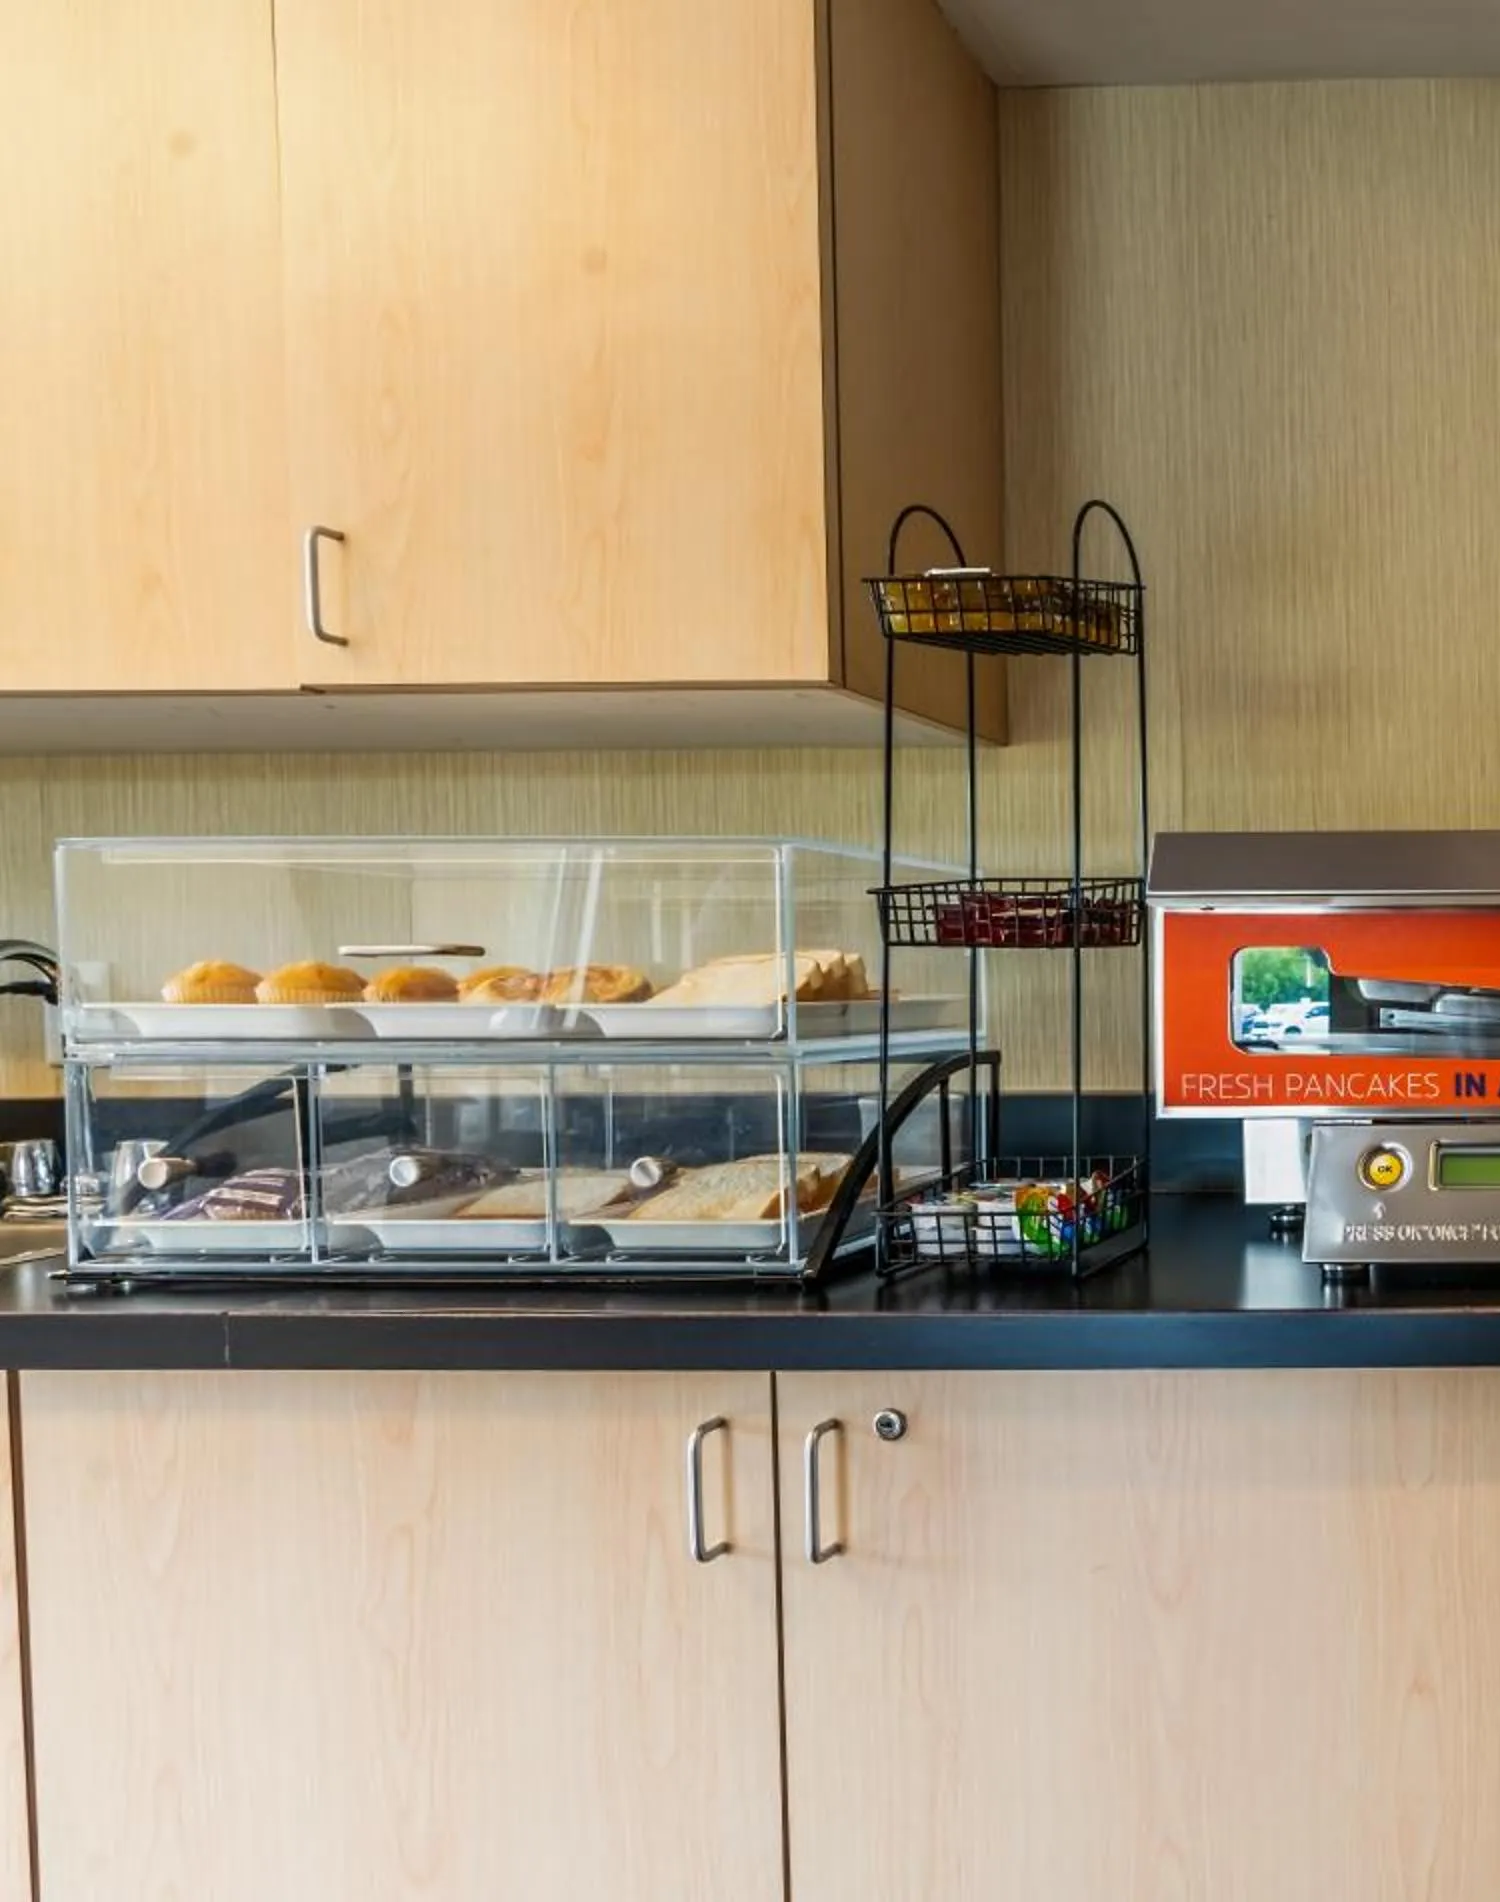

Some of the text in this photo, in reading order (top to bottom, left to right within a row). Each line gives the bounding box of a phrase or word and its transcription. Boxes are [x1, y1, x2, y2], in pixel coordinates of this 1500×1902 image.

[1181, 1073, 1273, 1099] FRESH
[1286, 1073, 1440, 1099] PANCAKES
[1455, 1073, 1486, 1097] IN
